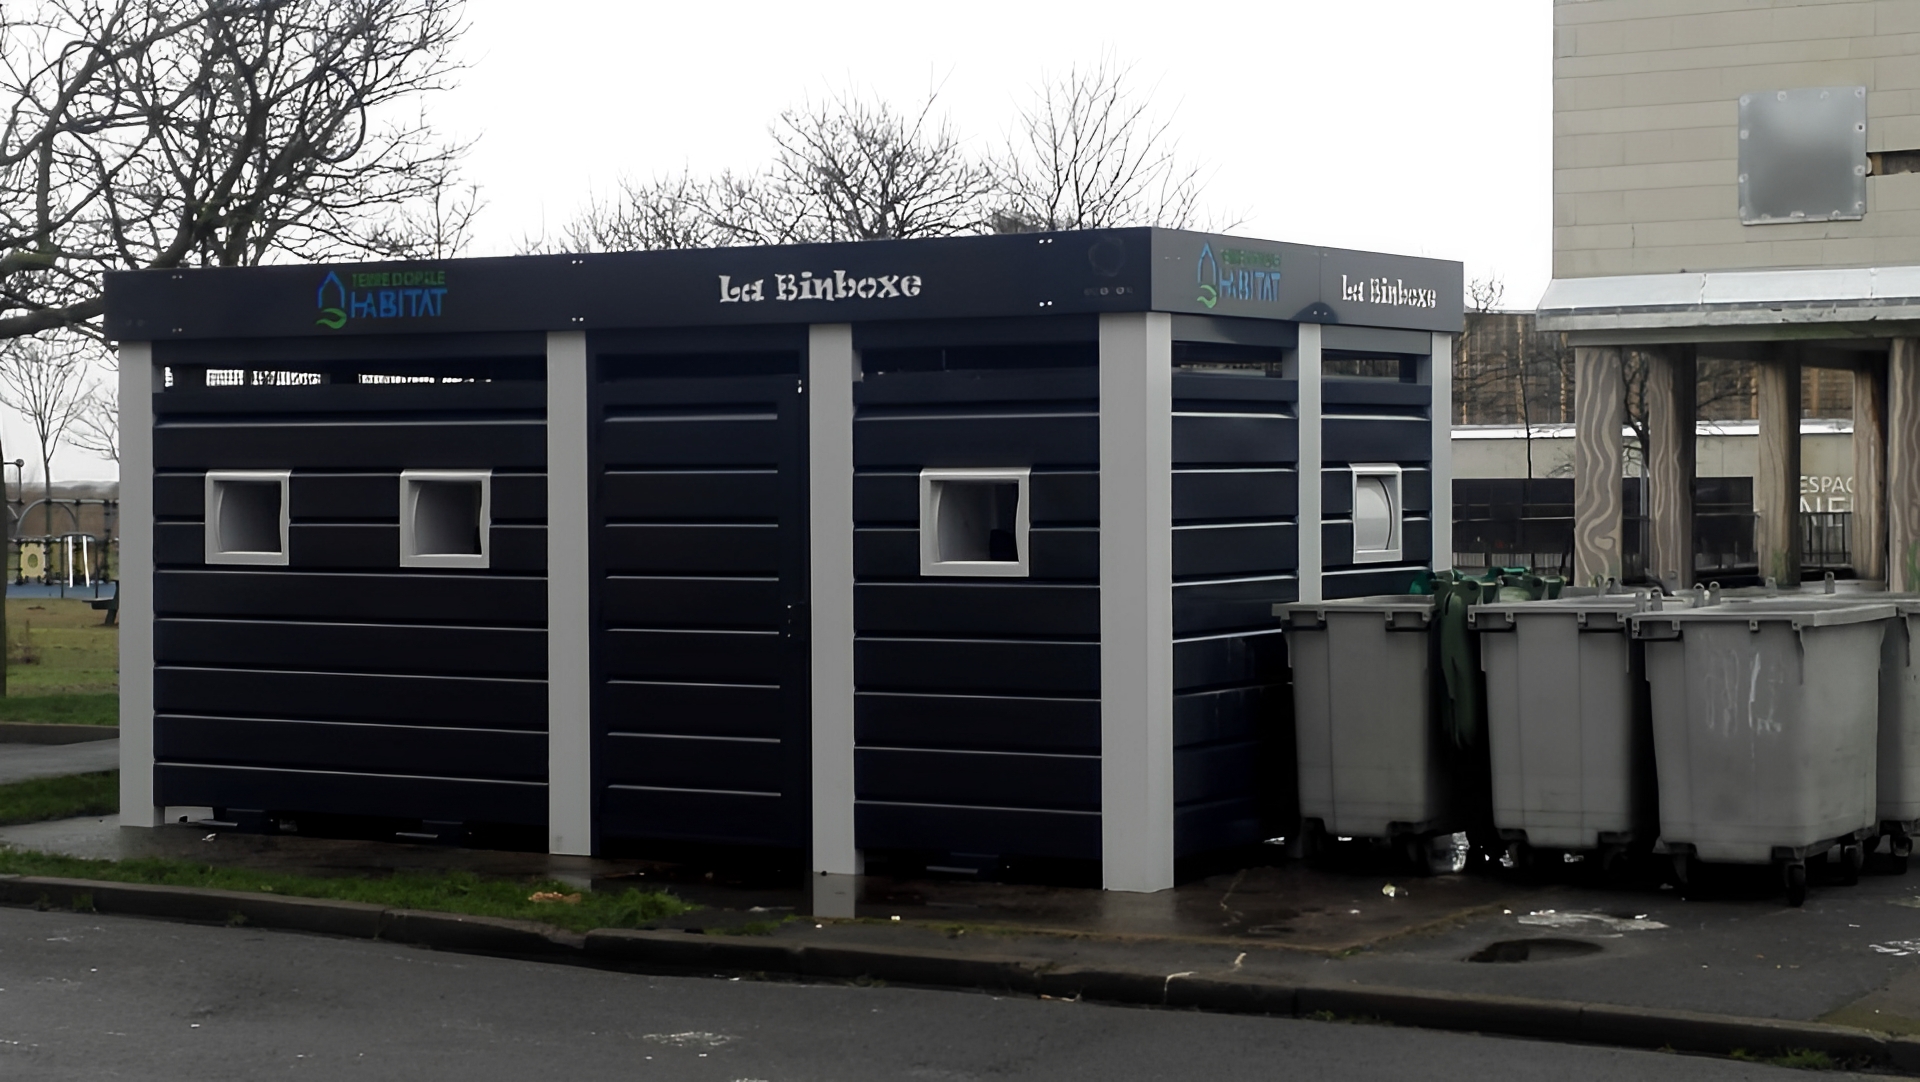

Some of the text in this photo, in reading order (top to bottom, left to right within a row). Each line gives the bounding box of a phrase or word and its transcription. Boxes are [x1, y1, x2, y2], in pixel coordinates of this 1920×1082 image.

[718, 269, 922, 303] La Binboxe
[1342, 274, 1364, 302] La
[350, 288, 448, 318] HABITAT
